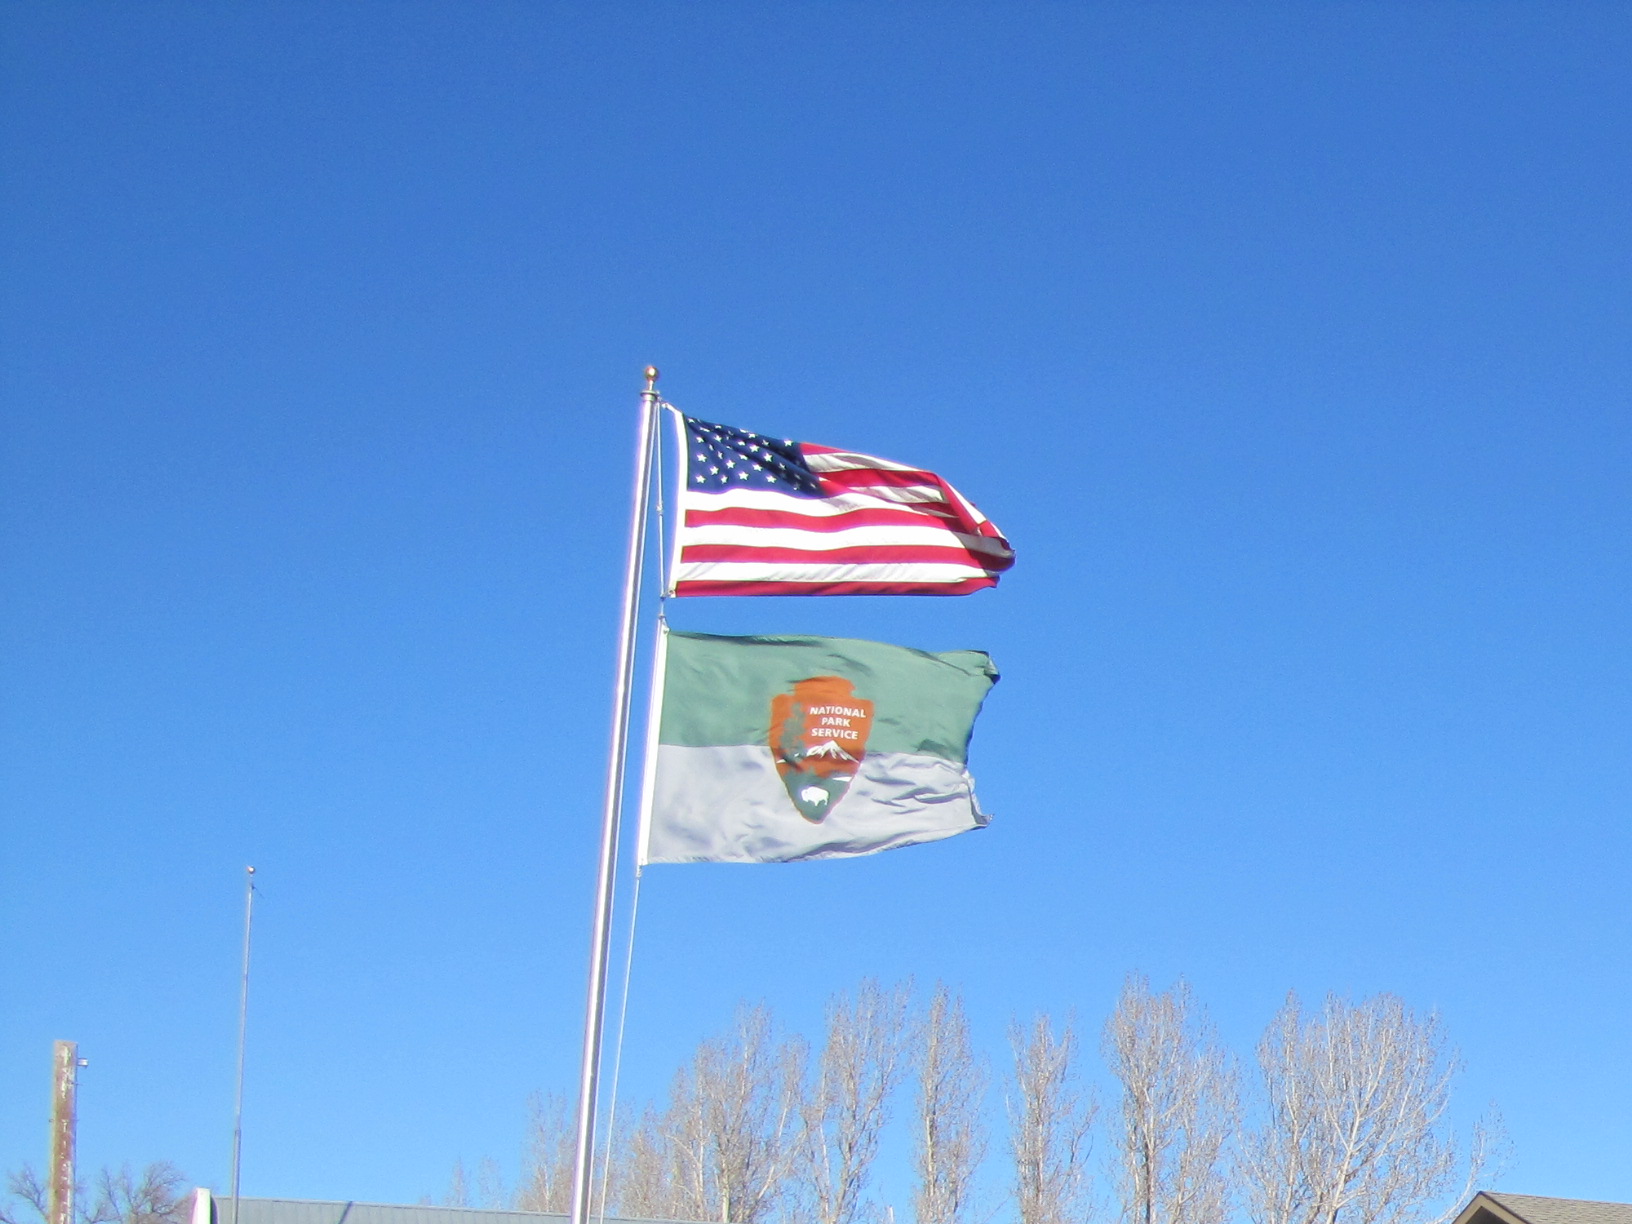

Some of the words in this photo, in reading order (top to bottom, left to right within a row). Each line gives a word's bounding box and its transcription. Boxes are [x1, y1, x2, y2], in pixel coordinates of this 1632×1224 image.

[809, 705, 866, 718] NATIONAL
[821, 716, 851, 727] PARK
[811, 728, 858, 740] SERVICE
